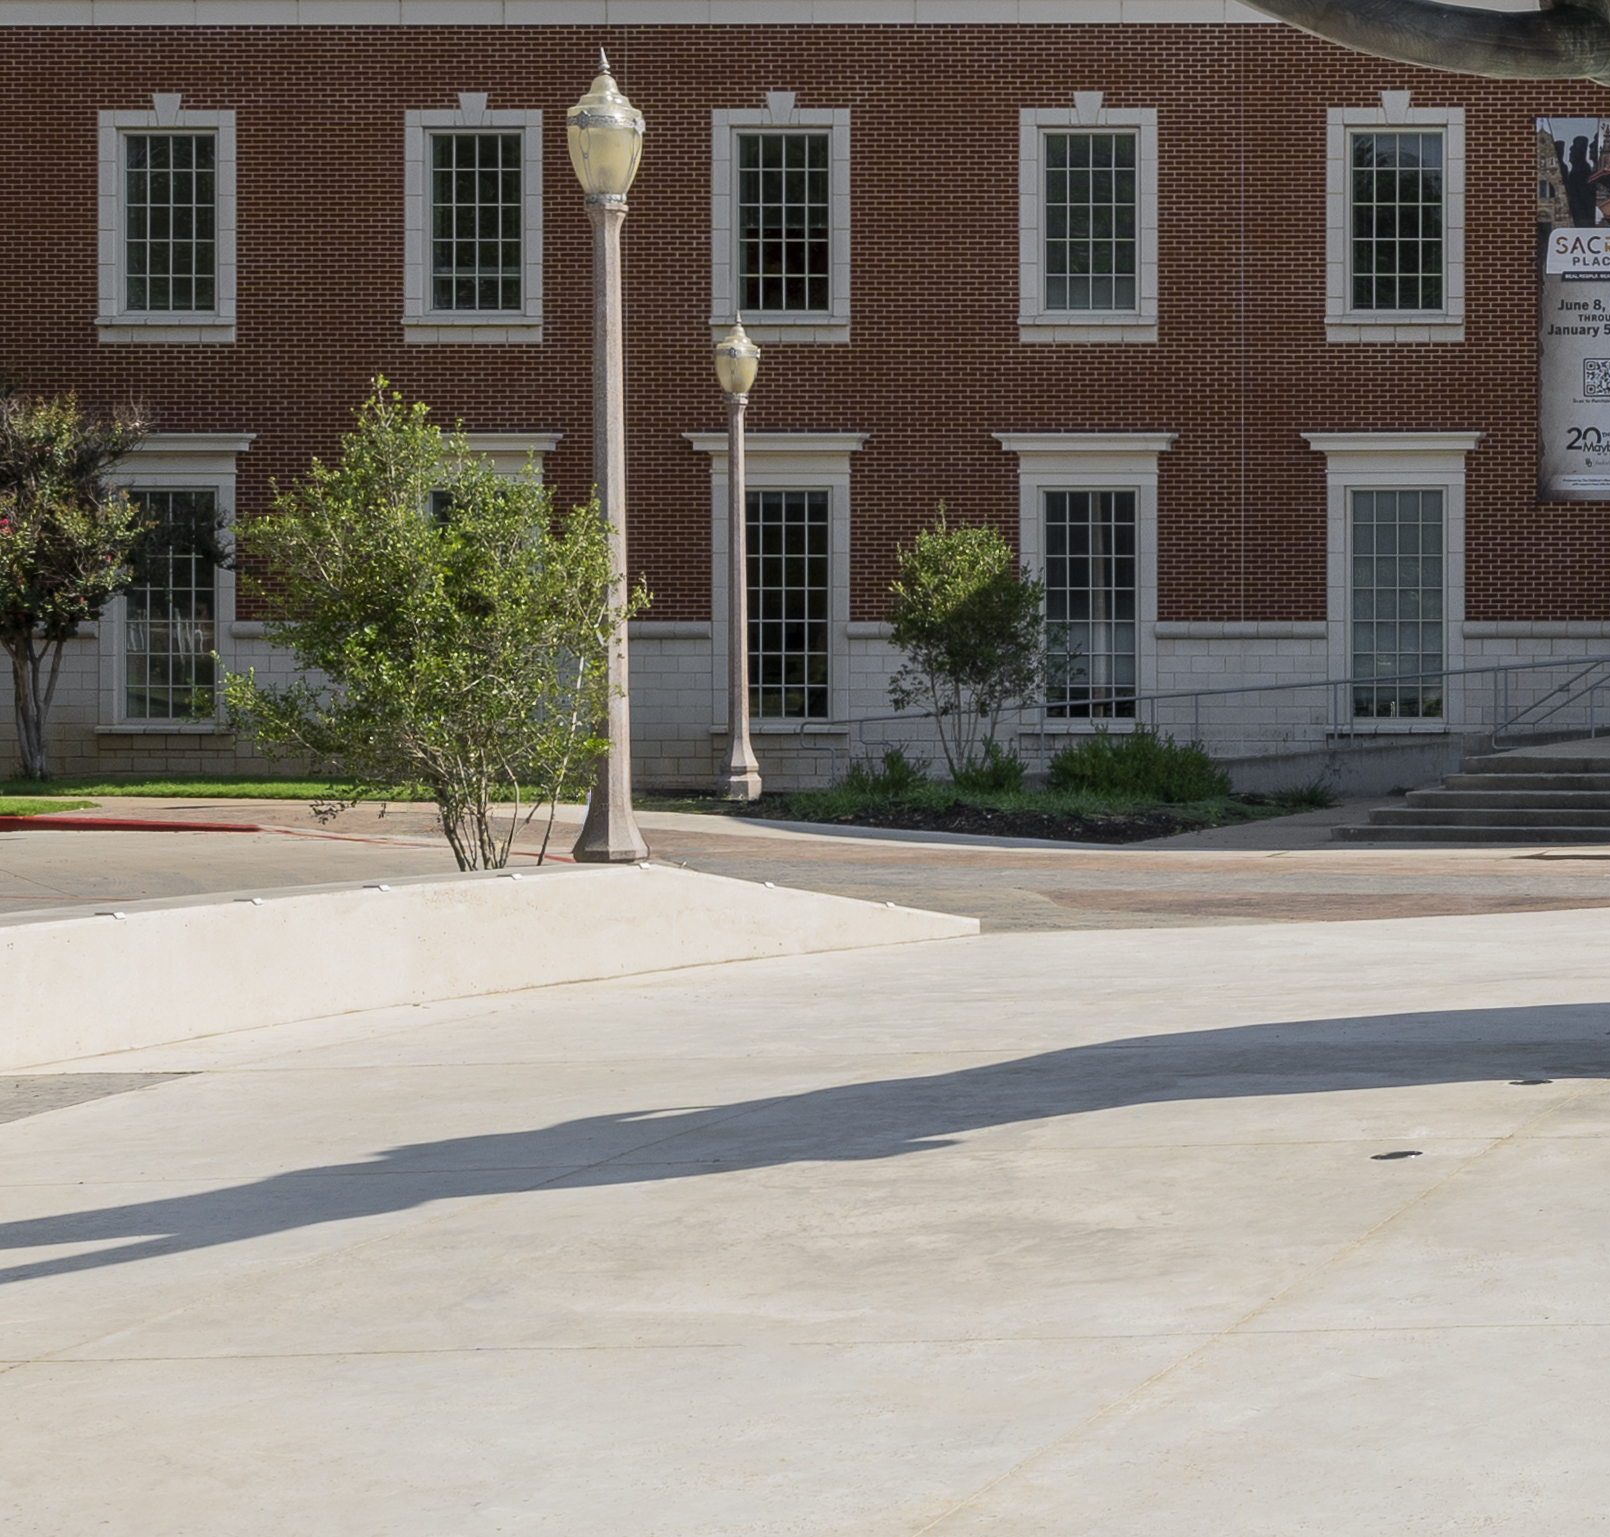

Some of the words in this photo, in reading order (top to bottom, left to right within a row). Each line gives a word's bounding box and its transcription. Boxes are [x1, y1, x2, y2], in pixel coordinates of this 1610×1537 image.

[1558, 299, 1589, 310] June
[1593, 299, 1605, 312] 8,
[1547, 324, 1599, 338] January
